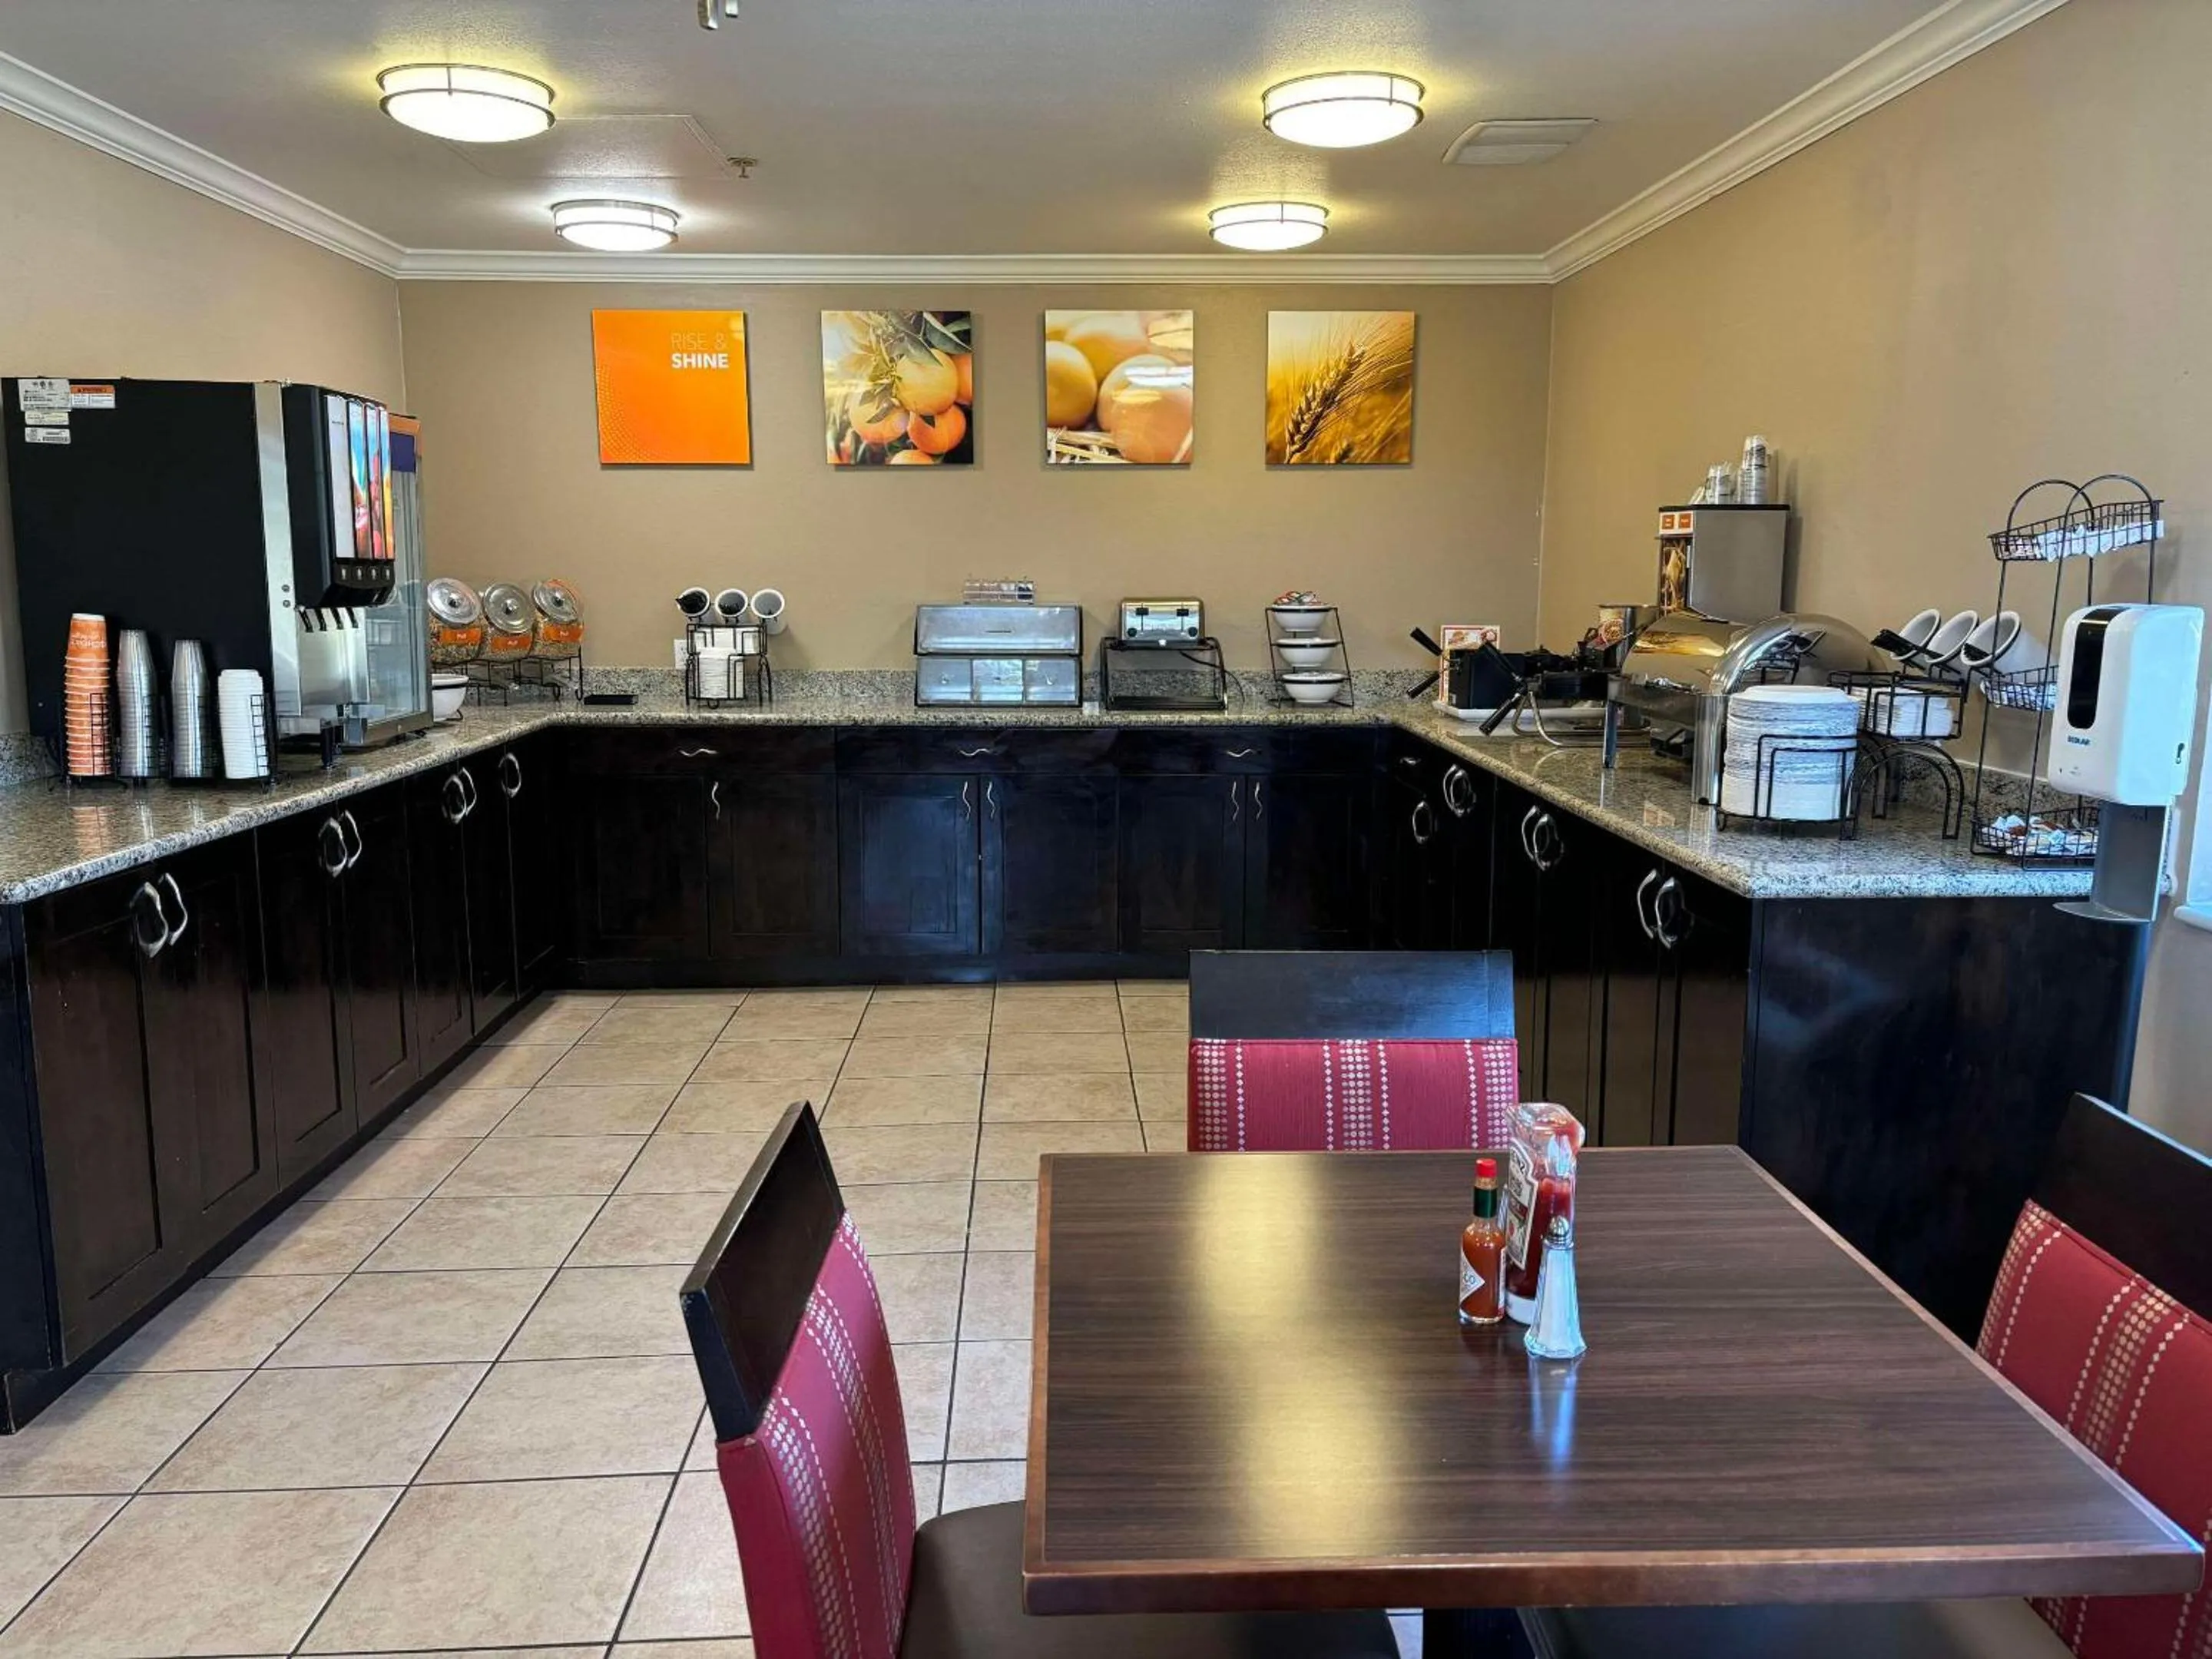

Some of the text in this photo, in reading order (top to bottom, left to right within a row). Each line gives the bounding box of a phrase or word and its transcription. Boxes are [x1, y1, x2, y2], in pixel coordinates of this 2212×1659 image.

[671, 332, 728, 351] RISE &
[671, 353, 729, 369] SHINE
